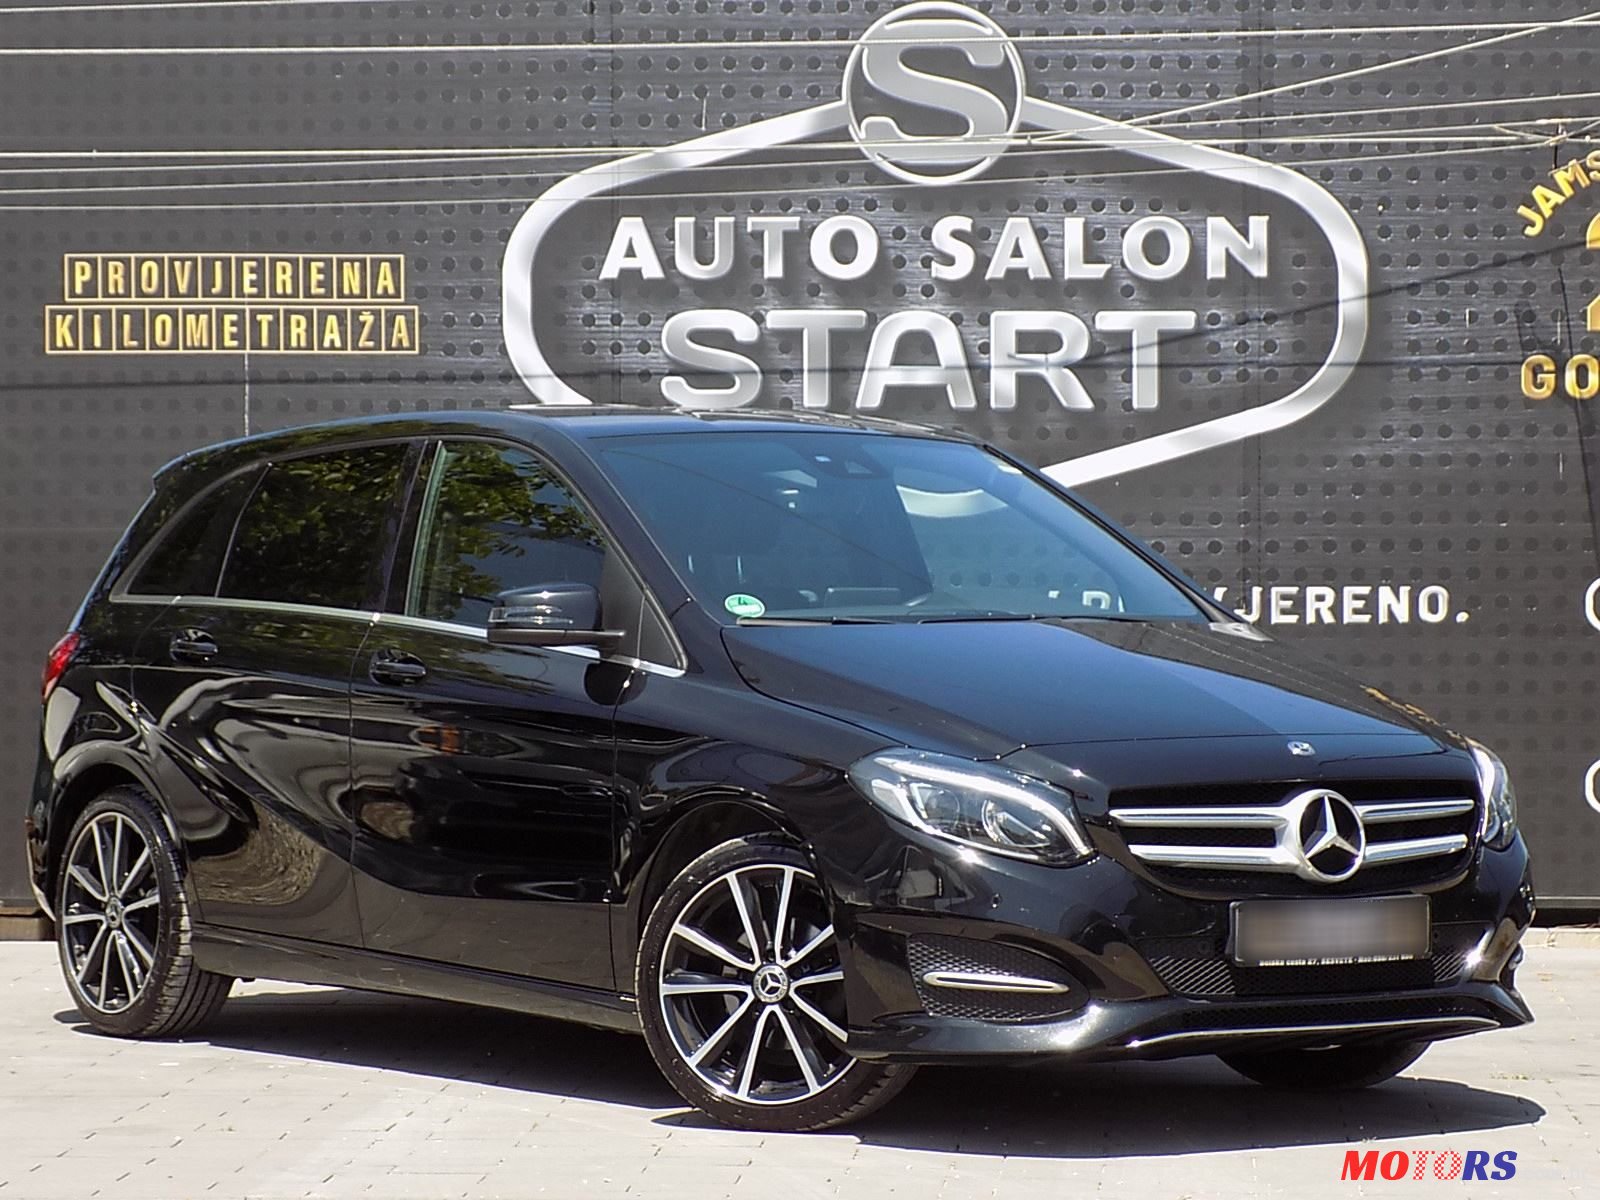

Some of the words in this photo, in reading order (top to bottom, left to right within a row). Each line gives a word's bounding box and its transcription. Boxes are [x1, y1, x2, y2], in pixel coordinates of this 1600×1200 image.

[599, 215, 879, 280] AUTO
[930, 215, 1270, 281] SALON
[73, 260, 396, 296] PROVJERENA
[55, 309, 409, 348] KILOMETRAŽA
[660, 309, 1197, 411] START
[1083, 586, 1470, 625] JERENO.
